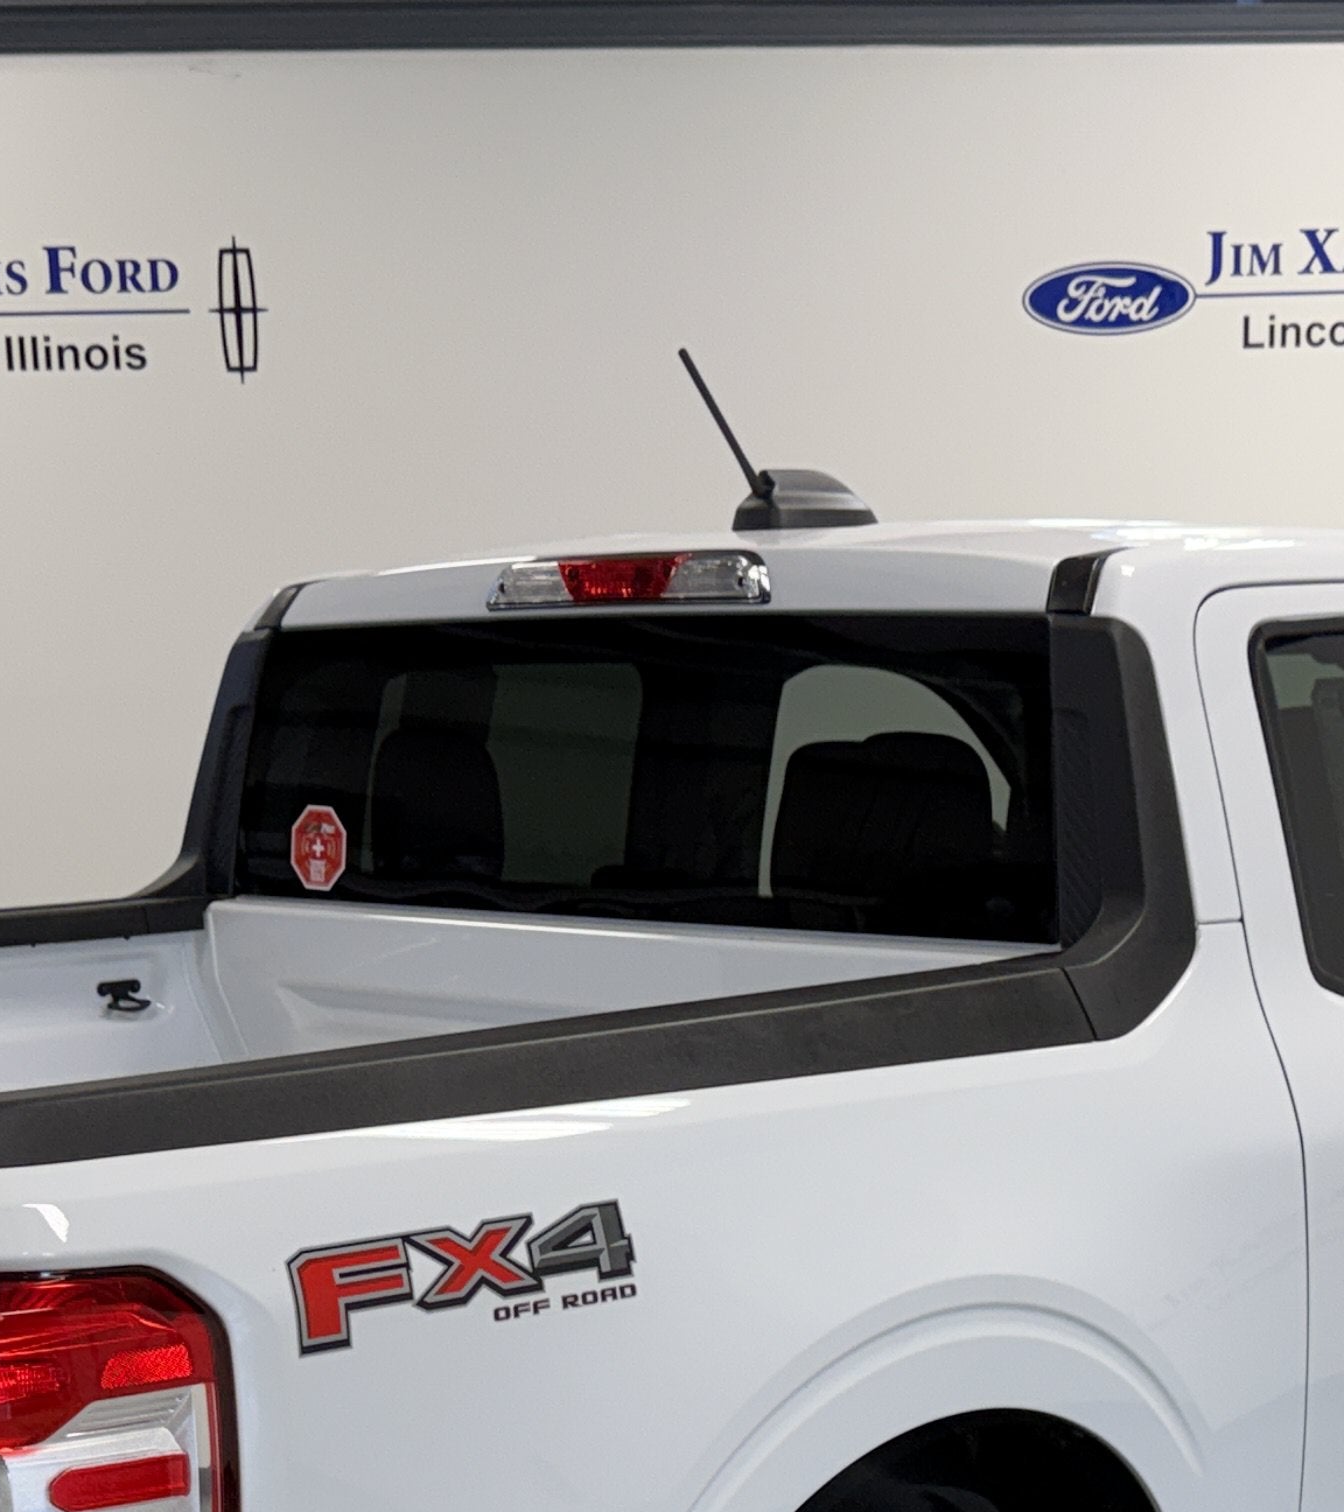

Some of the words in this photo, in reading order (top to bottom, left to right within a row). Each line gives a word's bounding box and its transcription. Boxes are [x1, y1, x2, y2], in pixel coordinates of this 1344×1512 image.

[43, 245, 180, 295] FORD
[1205, 230, 1283, 287] JIM
[1056, 275, 1161, 324] Ford
[4, 336, 148, 372] Illinois
[286, 1198, 637, 1359] FX4
[493, 1298, 552, 1323] OFF
[561, 1282, 637, 1312] ROAD
